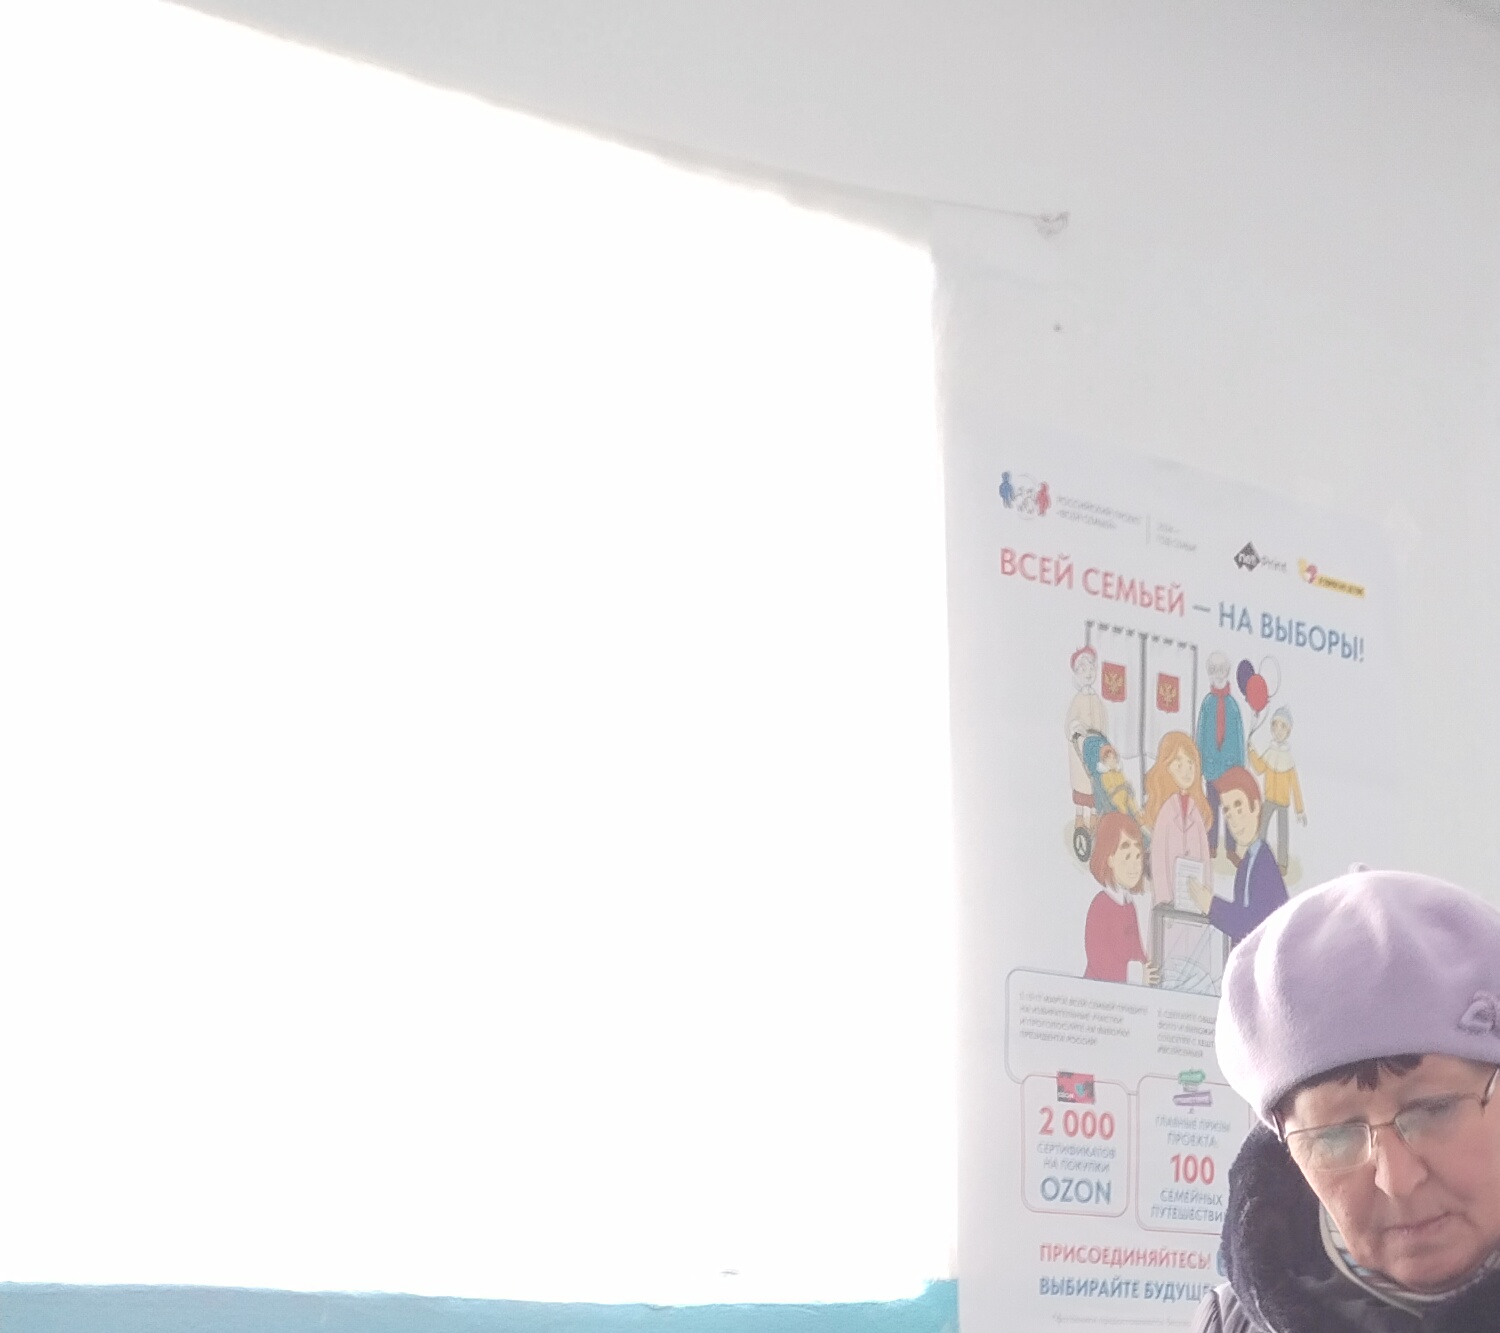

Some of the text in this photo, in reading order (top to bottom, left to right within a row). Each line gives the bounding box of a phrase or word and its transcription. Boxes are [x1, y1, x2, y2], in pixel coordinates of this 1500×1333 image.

[1000, 548, 1074, 589] ВСЕЙ
[1082, 567, 1185, 617] СЕМЬЕЙ
[1219, 602, 1252, 634] НА
[1261, 611, 1365, 662] ВЫБОРЫ!
[1039, 1107, 1116, 1140] 2 000
[1155, 1115, 1197, 1131] ГЛАВНЫЕ
[1037, 1142, 1116, 1160] СЕРТИФИКАТОВ
[1044, 1158, 1110, 1174] НА ПОКУПКИ
[1170, 1153, 1215, 1185] 100
[1040, 1176, 1112, 1205] OZON
[1160, 1187, 1222, 1206] СЕМЕЙНЫХ
[1151, 1205, 1225, 1223] ПУТЕШЕСТВИ
[1040, 1242, 1210, 1270] ПРИСОЕДИНЯЙТЕСЬ!
[1039, 1276, 1140, 1299] ВЫБИРАЙТЕ
